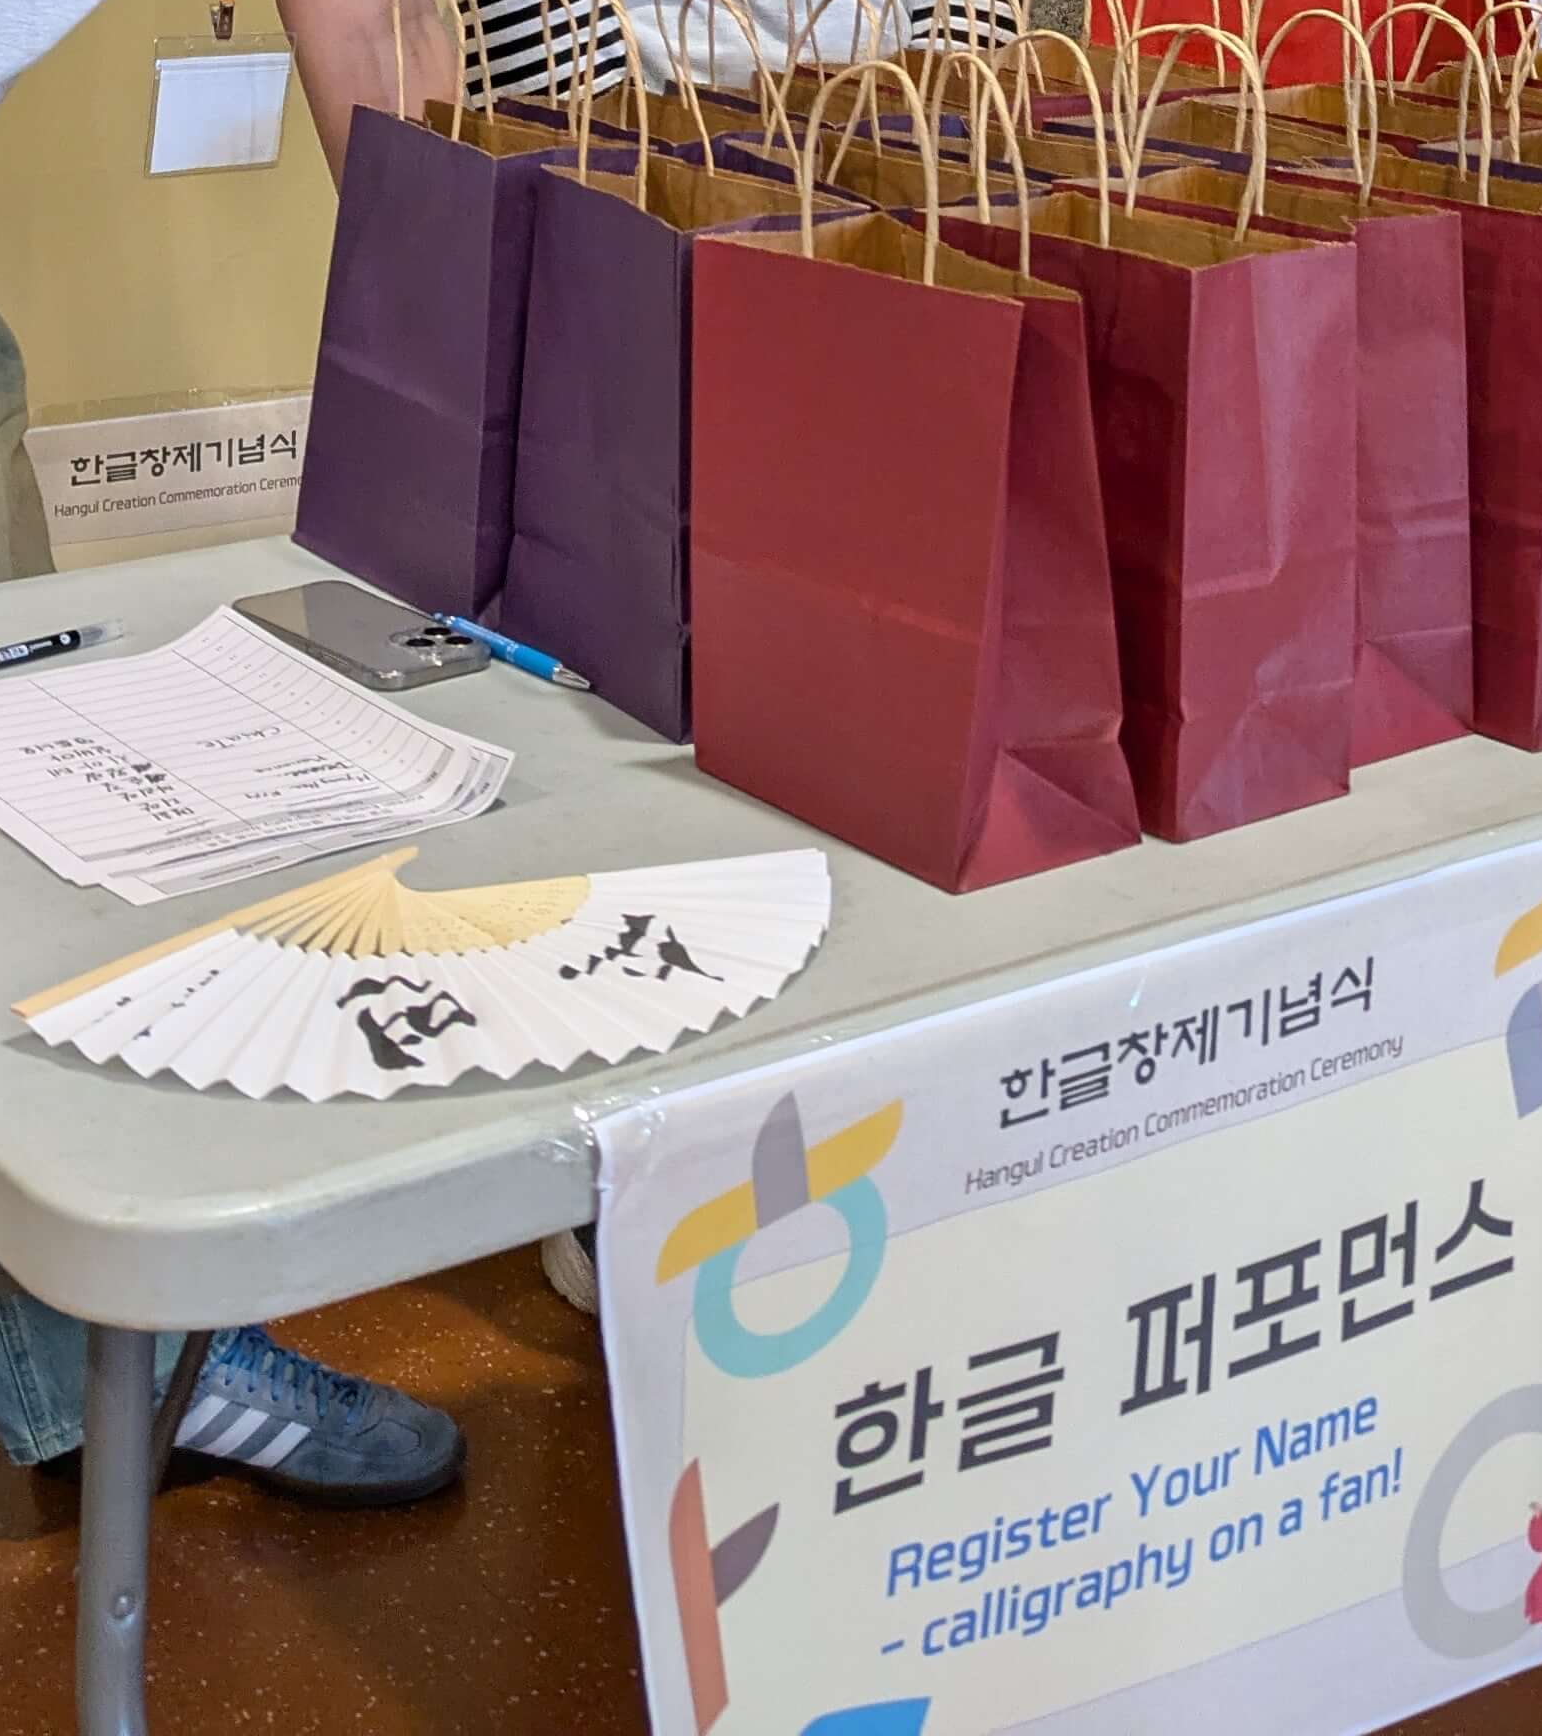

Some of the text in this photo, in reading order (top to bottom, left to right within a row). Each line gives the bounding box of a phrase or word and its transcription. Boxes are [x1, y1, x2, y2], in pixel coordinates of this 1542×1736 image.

[54, 476, 302, 517] Hangul Creation Commemoration Ceremo
[70, 429, 297, 486] 한글창제기념식
[964, 1034, 1404, 1194] Hangul Creation Commemoration Ceremony
[999, 956, 1374, 1129] 한글창제기념식
[833, 1178, 1515, 1515] 한글 퍼포먼스
[886, 1395, 1378, 1596] Register Your Name
[922, 1534, 1193, 1656] calligraphy
[1209, 1512, 1264, 1563] on
[1277, 1498, 1303, 1537] a
[1318, 1448, 1404, 1523] fan!
